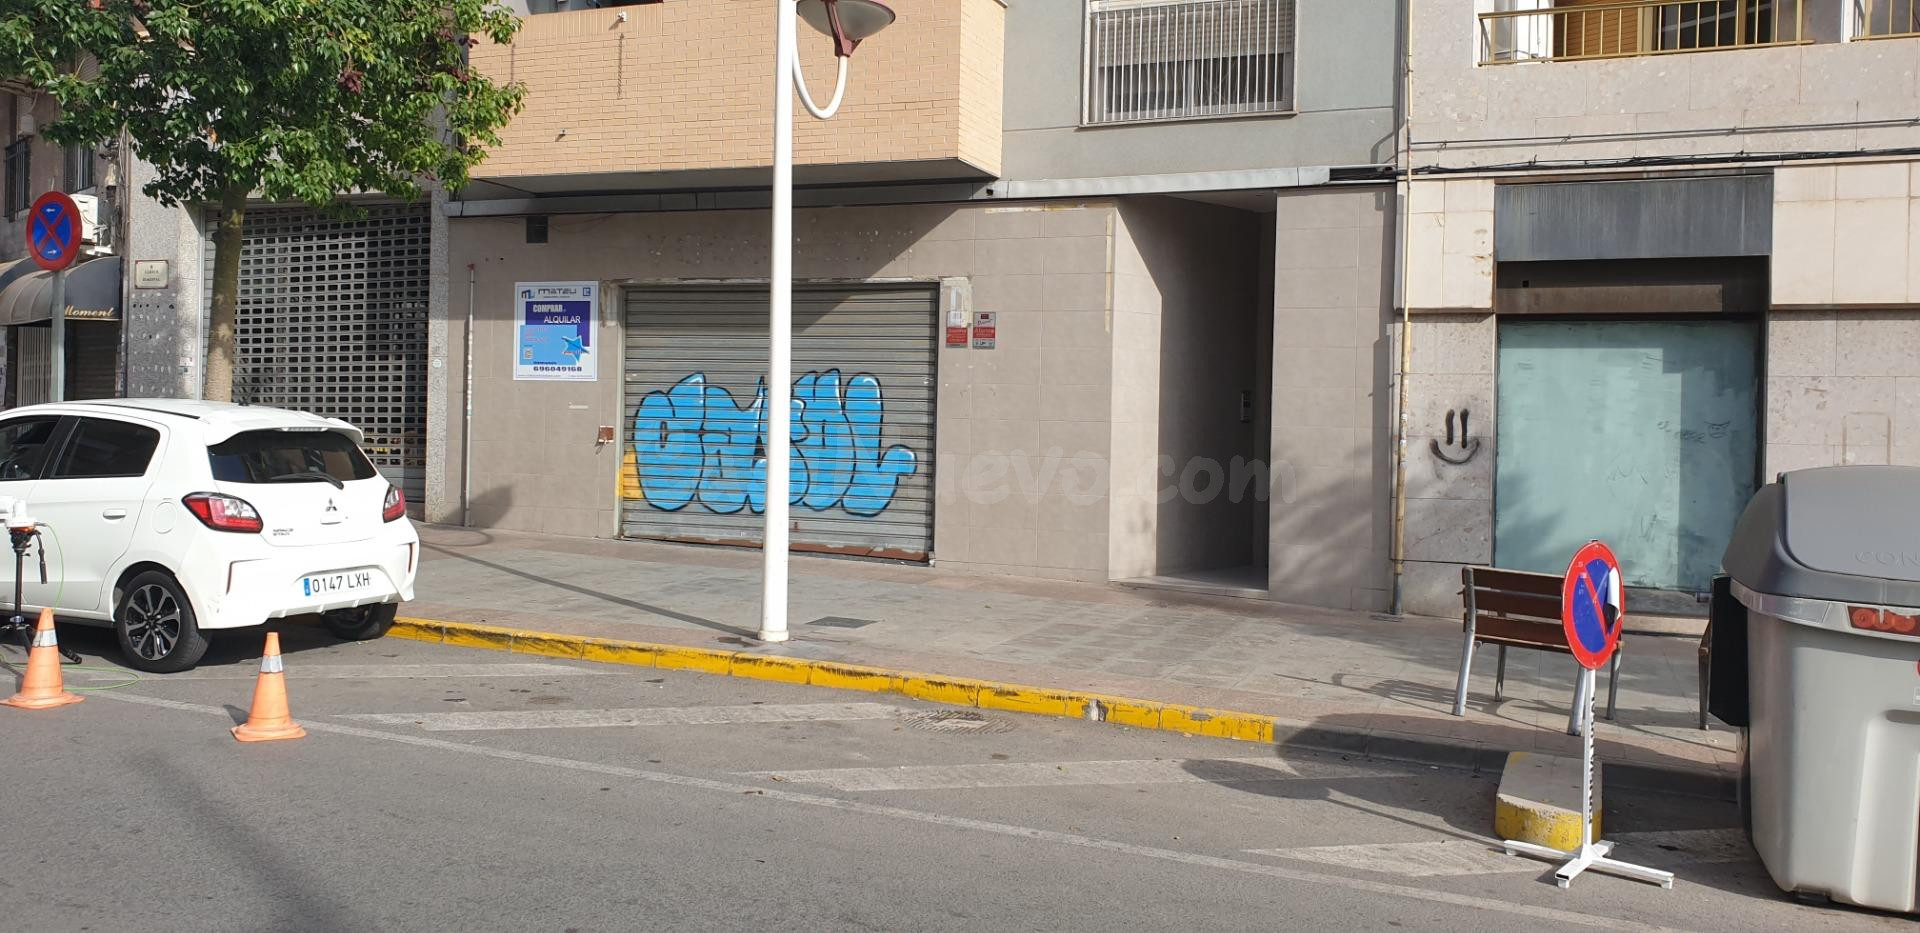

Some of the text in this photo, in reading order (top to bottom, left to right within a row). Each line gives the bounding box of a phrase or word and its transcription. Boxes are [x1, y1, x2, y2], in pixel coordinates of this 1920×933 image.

[532, 304, 563, 313] COMPRAR
[543, 316, 581, 324] ALQUILAR
[312, 572, 370, 592] 0147 LXH
